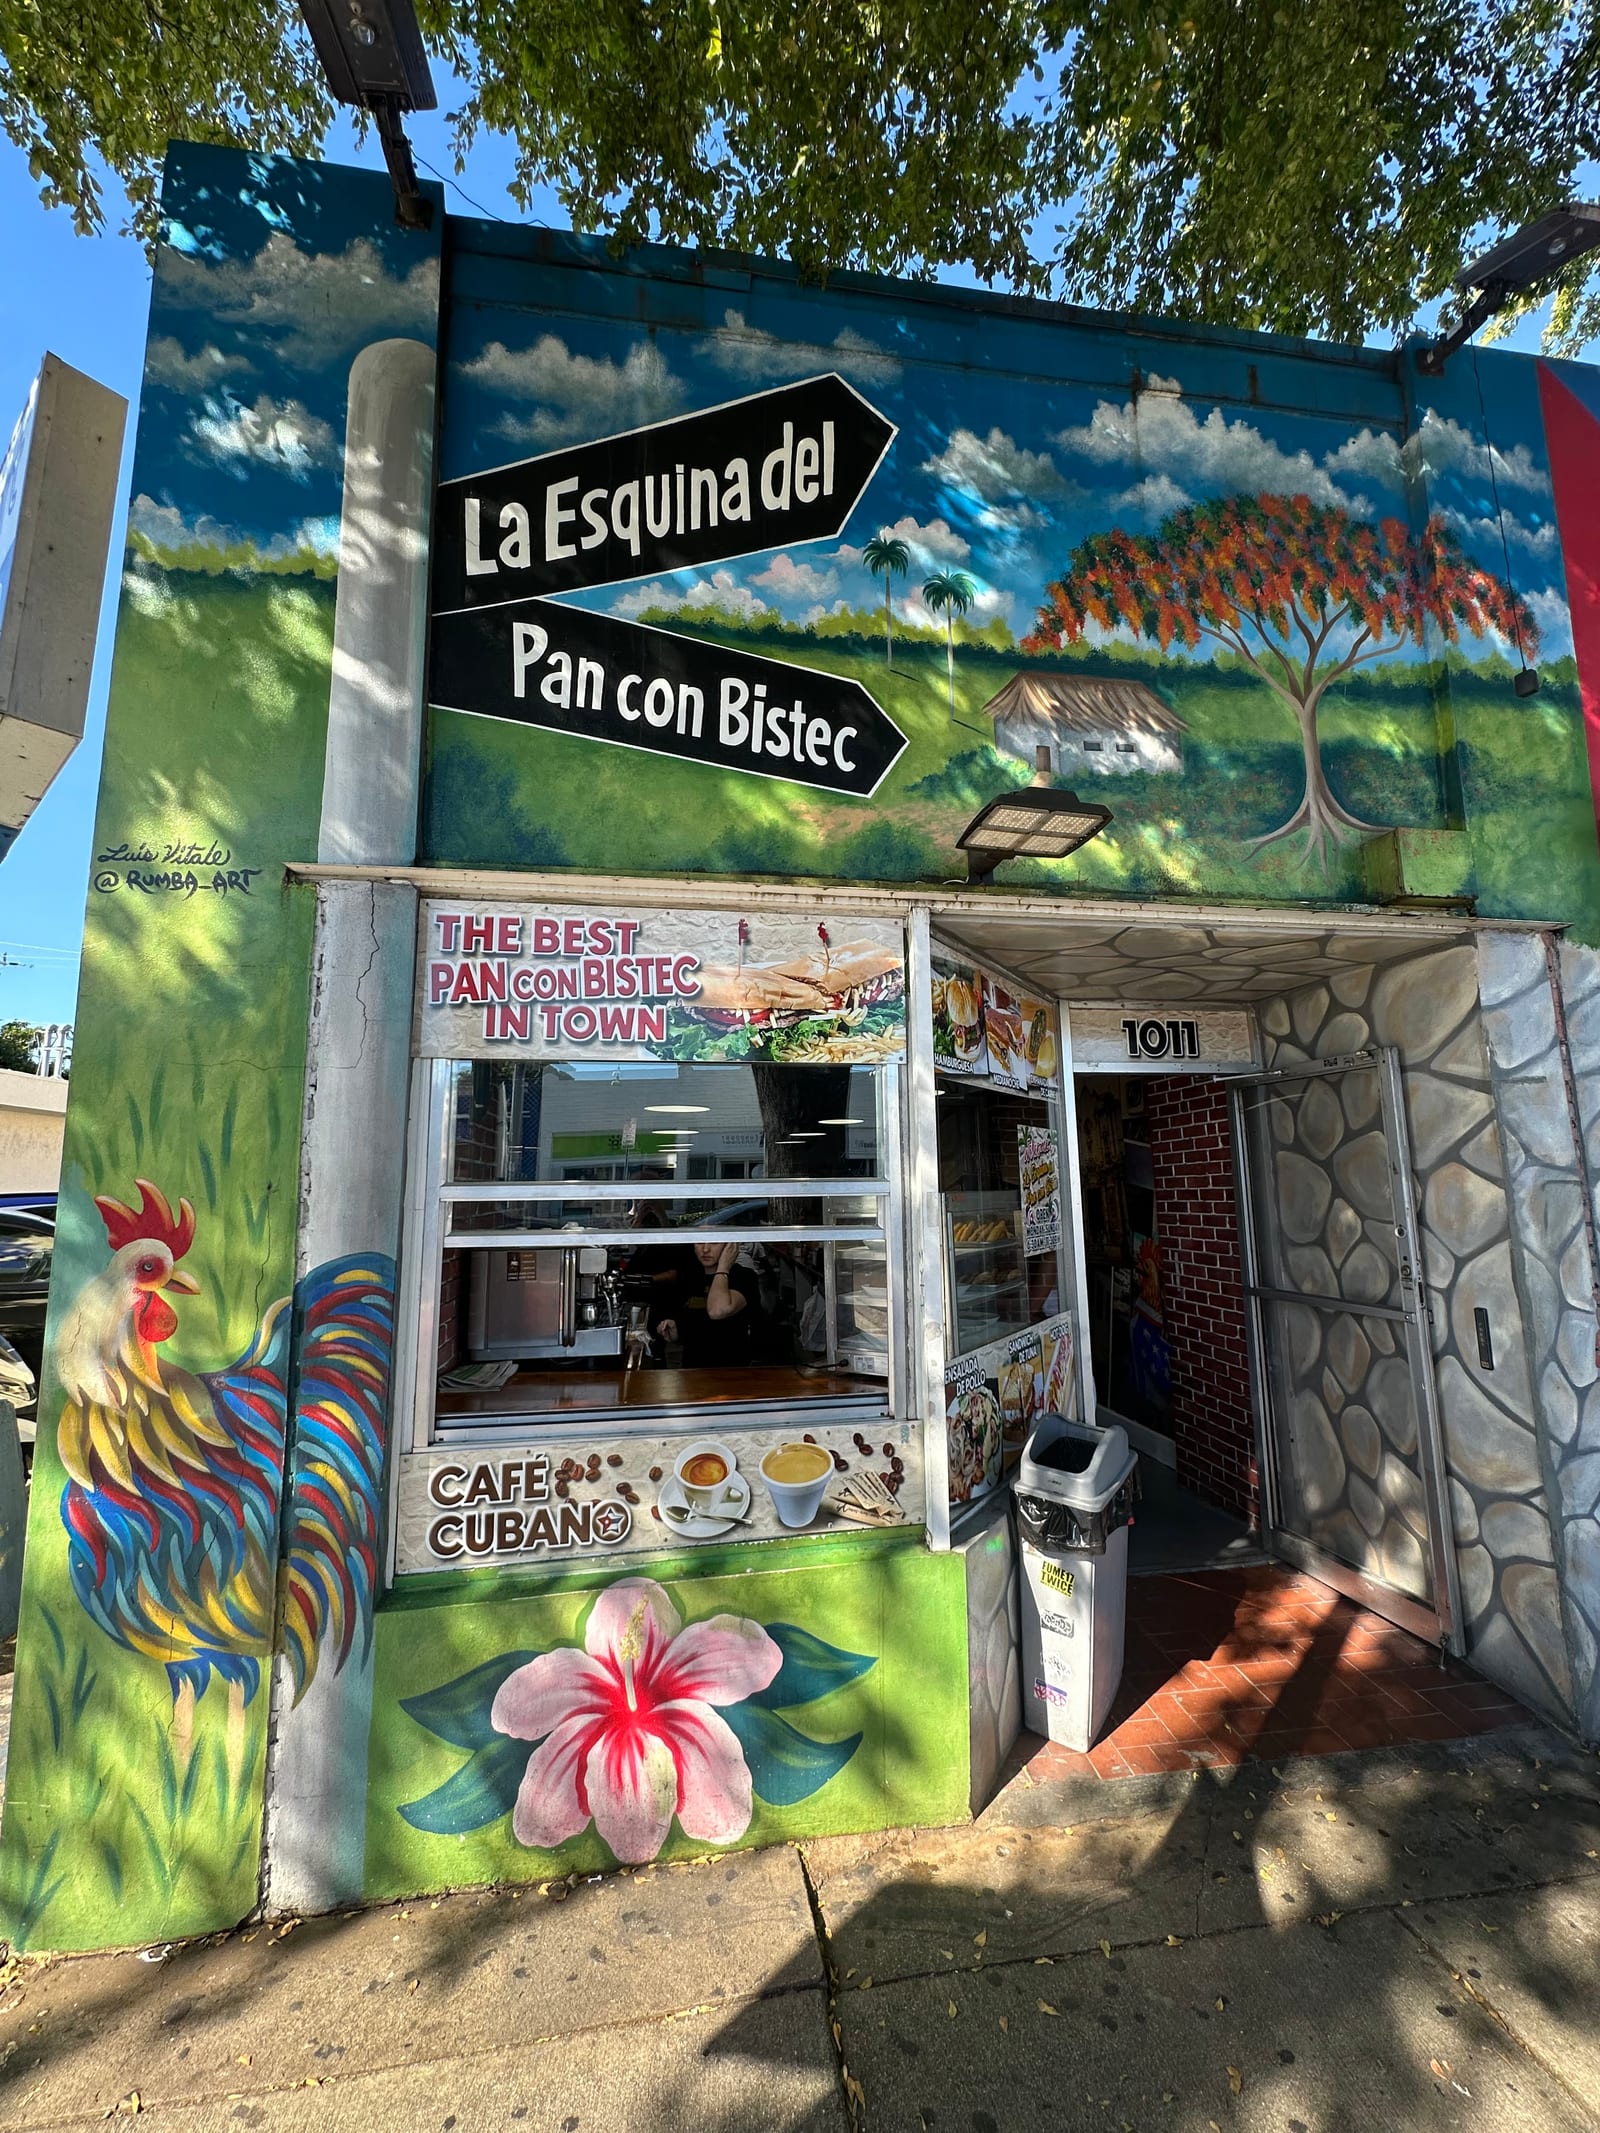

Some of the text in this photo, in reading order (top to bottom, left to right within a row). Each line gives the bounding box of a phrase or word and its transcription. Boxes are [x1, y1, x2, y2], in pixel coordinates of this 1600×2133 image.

[464, 421, 835, 576] La Esquina del
[512, 621, 858, 773] Pan con Bistec
[98, 839, 231, 867] Luis Vitale
[434, 914, 639, 957] THE BEST
[430, 954, 702, 1004] PAN CON BISTEC
[483, 1002, 667, 1044] IN TOWN
[1121, 1018, 1199, 1057] 1011
[934, 1053, 974, 1074] HAMBURGUESA
[1009, 1332, 1034, 1354] SANDWICH
[945, 1356, 979, 1382] ENSALADA
[957, 1369, 986, 1396] DE POLLO
[429, 1453, 549, 1506] CAFÉ
[428, 1500, 632, 1560] CUBANO
[1041, 1570, 1073, 1595] TWICE
